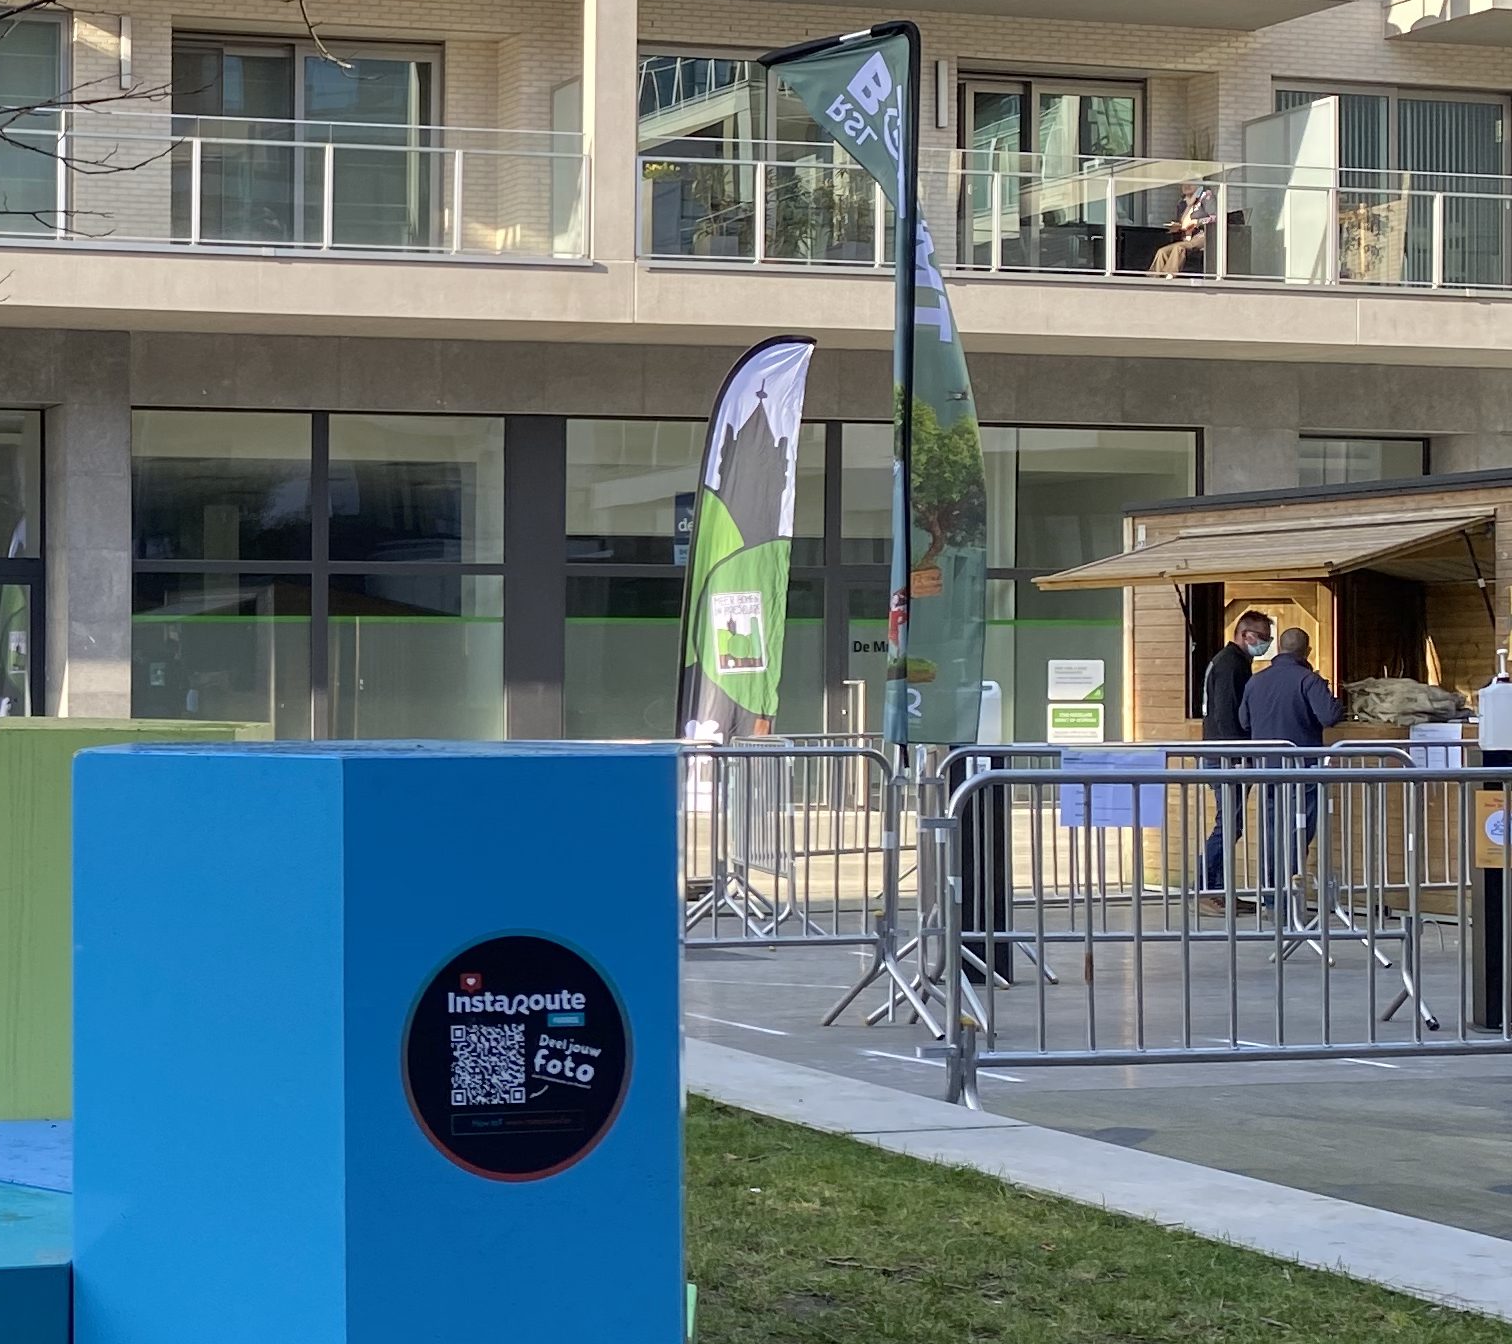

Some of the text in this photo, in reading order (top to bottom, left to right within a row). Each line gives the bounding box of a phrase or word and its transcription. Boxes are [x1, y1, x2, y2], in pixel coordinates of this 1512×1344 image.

[853, 640, 870, 653] De
[539, 1034, 602, 1058] Deel jouw
[534, 1048, 595, 1083] foto
